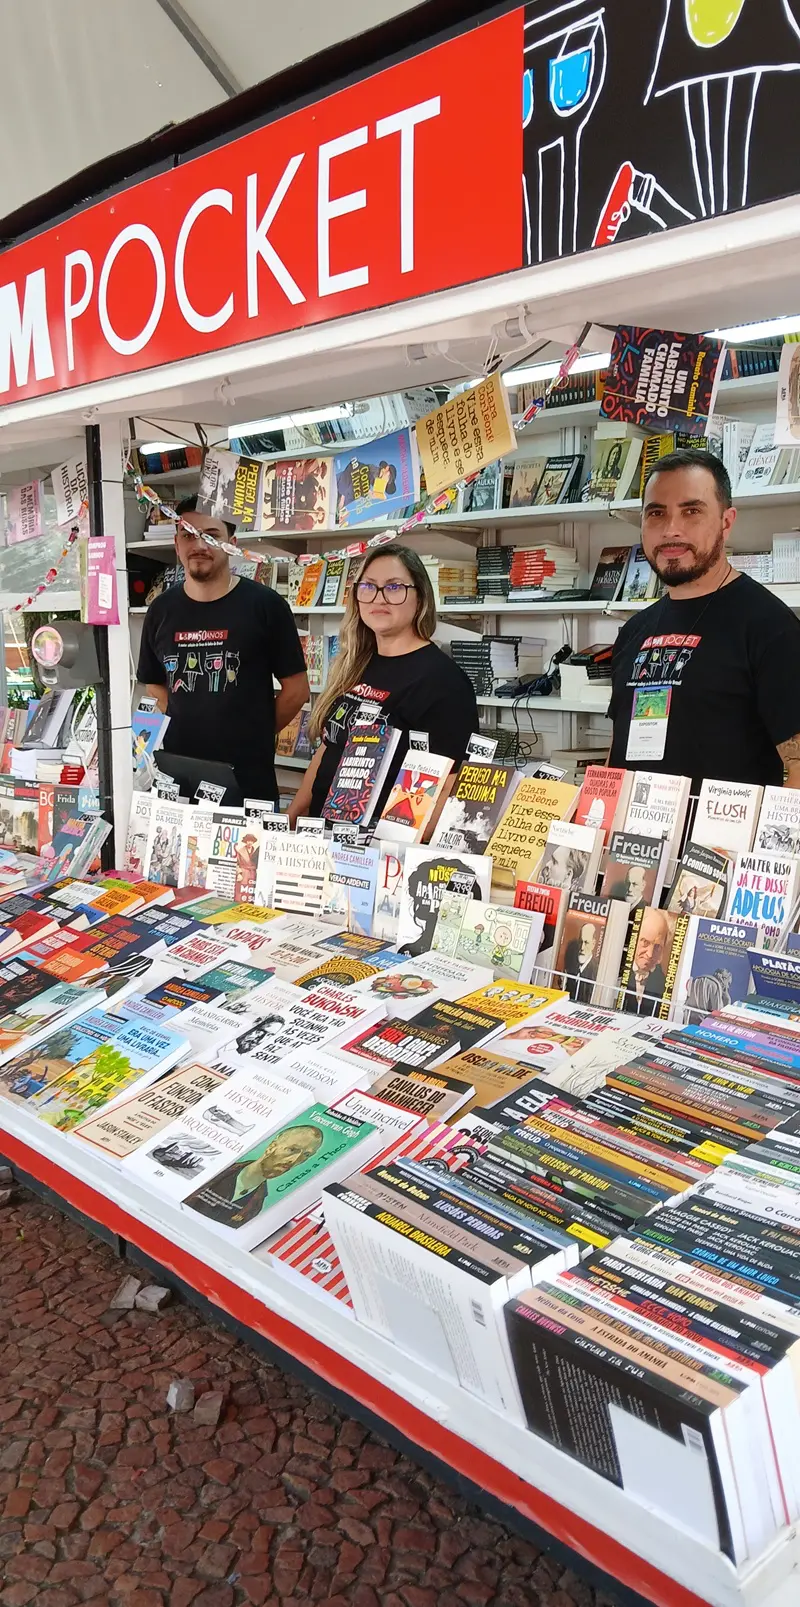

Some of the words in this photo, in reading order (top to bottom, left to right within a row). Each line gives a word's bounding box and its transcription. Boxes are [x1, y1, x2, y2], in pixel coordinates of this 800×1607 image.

[64, 96, 441, 372] POCKET
[635, 348, 656, 404] FAMÍLIA
[695, 351, 707, 380] Renato
[646, 343, 668, 413] CHAMADO
[656, 343, 683, 417] LABIRINTO
[674, 370, 688, 394] UM
[485, 381, 498, 420] Clara
[425, 419, 436, 436] de
[456, 399, 467, 439] folha
[462, 436, 472, 459] do
[466, 391, 478, 426] Vire
[473, 427, 484, 463] essa
[428, 440, 440, 464] mim
[446, 406, 457, 451] livro
[455, 459, 464, 476] se
[70, 480, 77, 494] DA
[232, 466, 248, 516] ESQUINA
[247, 463, 260, 504] PERIGO
[242, 505, 254, 523] NA
[342, 757, 376, 767] LABIRINTO
[355, 746, 368, 756] UM
[337, 777, 363, 790] FAMÍLIA
[339, 768, 370, 779] CHAMADO
[459, 765, 492, 784] PERIGO
[491, 770, 507, 788] NA
[587, 770, 607, 779] FERNANDO
[57, 793, 76, 804] Frida
[456, 783, 497, 804] ESQUINA
[516, 793, 559, 807] Corleone
[520, 784, 547, 795] Clara
[708, 785, 732, 796] Virginia
[733, 789, 751, 798] Woolf
[510, 804, 534, 816] Vire
[629, 807, 674, 825] FILOSOFIA
[706, 800, 747, 820] FLUSH
[497, 829, 528, 845] livro
[503, 817, 532, 831] folha
[534, 821, 548, 834] do
[439, 832, 462, 846] TAILOR
[612, 835, 663, 860] Freud
[500, 856, 518, 869] mim
[687, 856, 713, 875] contrato
[740, 857, 770, 873] WALTER
[774, 863, 791, 876] RISO
[737, 871, 748, 887] JÁ
[752, 874, 762, 889] TE
[765, 877, 788, 895] DISSE
[518, 891, 555, 916] FREUD
[569, 892, 609, 917] Freud
[635, 909, 643, 921] VIDA
[730, 887, 785, 924] ADEUS
[710, 924, 746, 938] PLATÃO
[317, 986, 357, 1002] CHARLES
[289, 1004, 315, 1017] VOCÊ
[309, 1013, 329, 1023] FICA
[328, 1018, 346, 1027] TÃO
[300, 993, 367, 1019] BUKOWSKI
[569, 1010, 594, 1020] POR
[591, 1015, 617, 1024] QUE
[289, 1018, 328, 1033] SOZINHO
[296, 1031, 324, 1042] VEZES
[391, 1021, 418, 1034] FLÁVIO
[418, 1030, 449, 1045] TAVARES
[117, 1033, 133, 1044] UMA
[128, 1028, 142, 1039] ERA
[140, 1034, 157, 1044] UMA
[155, 1039, 171, 1049] VEZ
[274, 1036, 294, 1045] QUE
[695, 1029, 738, 1046] HOMERO
[362, 1035, 428, 1067] DERROTADO
[461, 1053, 499, 1071] OSCAR
[289, 1061, 339, 1087] DAVIDSON
[376, 1088, 435, 1115] AMANHECER
[387, 1077, 432, 1099] CAVALOS
[427, 1091, 446, 1104] DO
[224, 1090, 273, 1118] HISTÓRIA
[344, 1096, 373, 1117] Uma
[369, 1106, 415, 1132] incrível
[97, 1121, 118, 1135] JASON
[113, 1127, 144, 1145] STANLEY
[177, 1114, 245, 1154] ARQUEOLOGIA
[309, 1110, 331, 1126] Vincent
[341, 1124, 362, 1139] Gogh
[513, 1128, 542, 1144] FREUD
[530, 1116, 557, 1133] FREUD
[276, 1169, 312, 1194] Cartas
[317, 1143, 347, 1163] Theo
[539, 1153, 572, 1173] NIETZSCHE
[579, 1170, 611, 1191] PARAGUAI
[503, 1192, 516, 1201] NADA
[713, 1201, 739, 1214] WILLIAM
[433, 1200, 465, 1222] ILUSÕES
[462, 1213, 504, 1241] PERDIDAS
[375, 1211, 413, 1238] AQUARELA
[409, 1229, 452, 1257] BRASILEIRA
[417, 1212, 458, 1241] Mansfield
[456, 1233, 481, 1253] Park
[668, 1208, 699, 1222] MAGGIE
[698, 1218, 735, 1234] CASSIDY
[736, 1233, 760, 1244] JACK
[758, 1239, 800, 1258] KEROUAC
[712, 1231, 729, 1240] JACK
[728, 1236, 762, 1252] KEROUAC
[707, 1235, 724, 1244] JACK
[723, 1240, 757, 1256] KEROUAC
[717, 1257, 727, 1265] DE
[726, 1259, 739, 1269] UM
[737, 1262, 758, 1275] AMOR
[756, 1270, 781, 1285] LOUCO
[600, 1256, 625, 1272] PARIS
[621, 1261, 667, 1290] LIBERTÁRIA
[665, 1285, 685, 1298] DAN
[682, 1292, 718, 1313] FRANCK
[535, 1295, 558, 1312] Melissa
[558, 1308, 569, 1316] da
[515, 1305, 540, 1321] CHARLES
[538, 1316, 567, 1335] BUKOWSKI
[597, 1328, 629, 1348] ESTRADA
[626, 1344, 640, 1353] DO
[608, 1355, 624, 1366] na
[624, 1365, 647, 1378] rua
